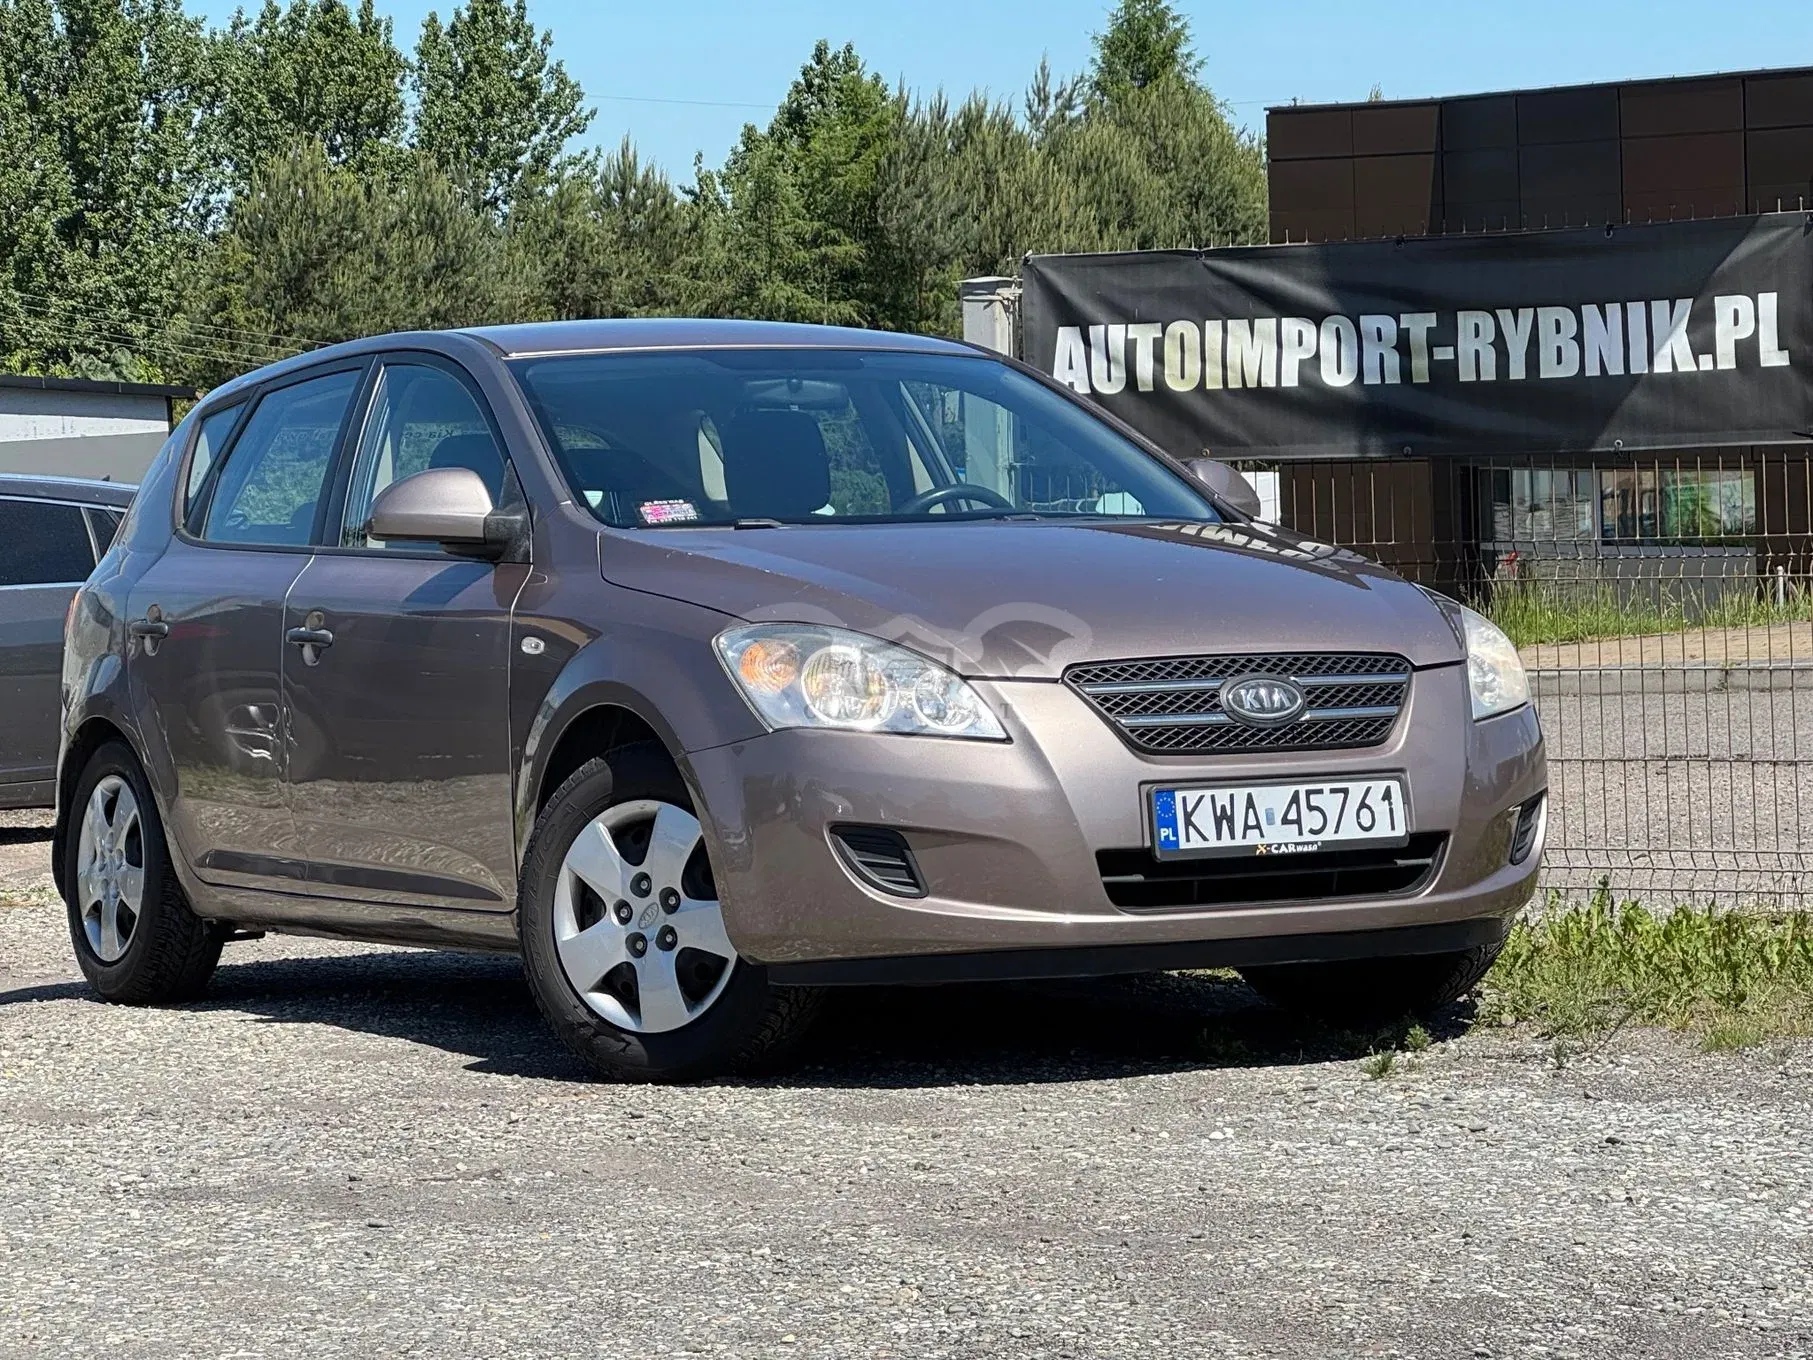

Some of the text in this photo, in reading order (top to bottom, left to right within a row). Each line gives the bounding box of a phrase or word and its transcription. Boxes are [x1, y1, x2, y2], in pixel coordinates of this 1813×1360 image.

[1052, 291, 1791, 395] AUTOIMPORT-RYBNIK.PL
[1239, 687, 1292, 710] KIA
[1160, 827, 1177, 842] PL
[1181, 785, 1397, 844] KWA 45761
